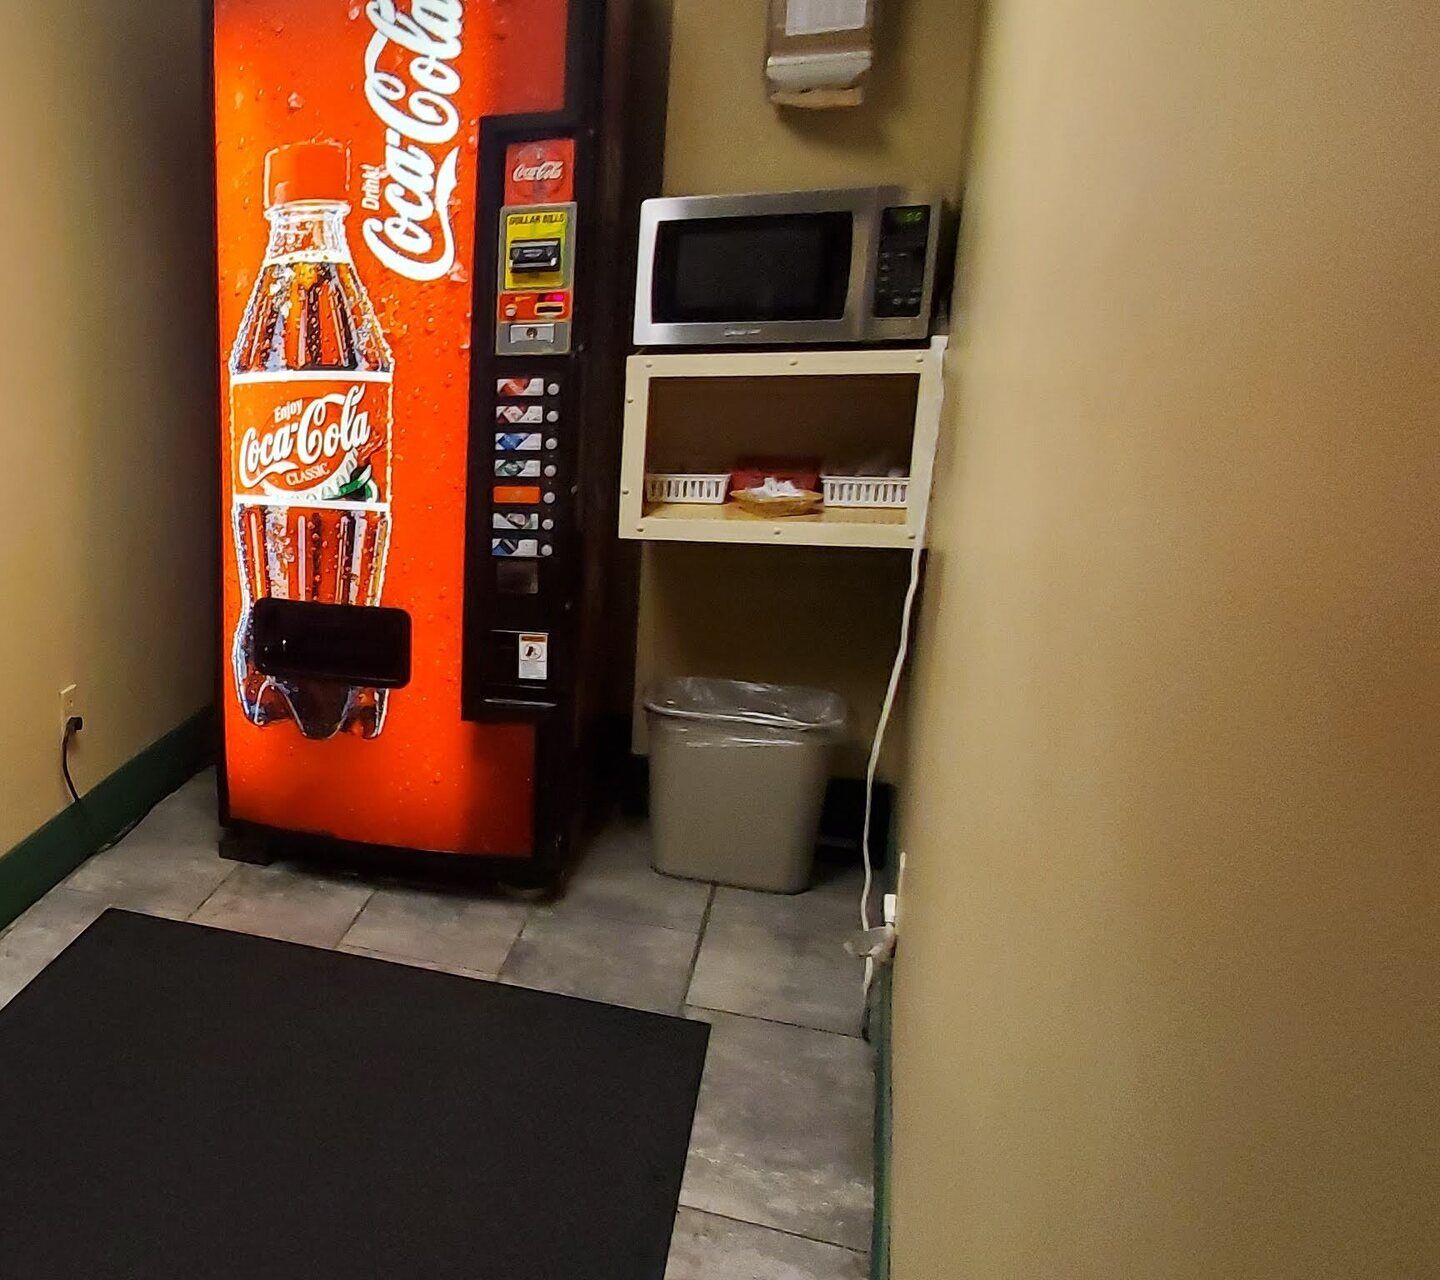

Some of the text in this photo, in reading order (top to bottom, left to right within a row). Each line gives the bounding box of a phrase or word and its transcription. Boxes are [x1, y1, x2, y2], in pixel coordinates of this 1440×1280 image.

[513, 160, 564, 182] Coca-Cola
[509, 214, 541, 225] DOLLAR
[273, 397, 304, 423] Enjoy
[238, 383, 371, 489] Coca-Cola
[285, 461, 331, 487] CLASSIC
